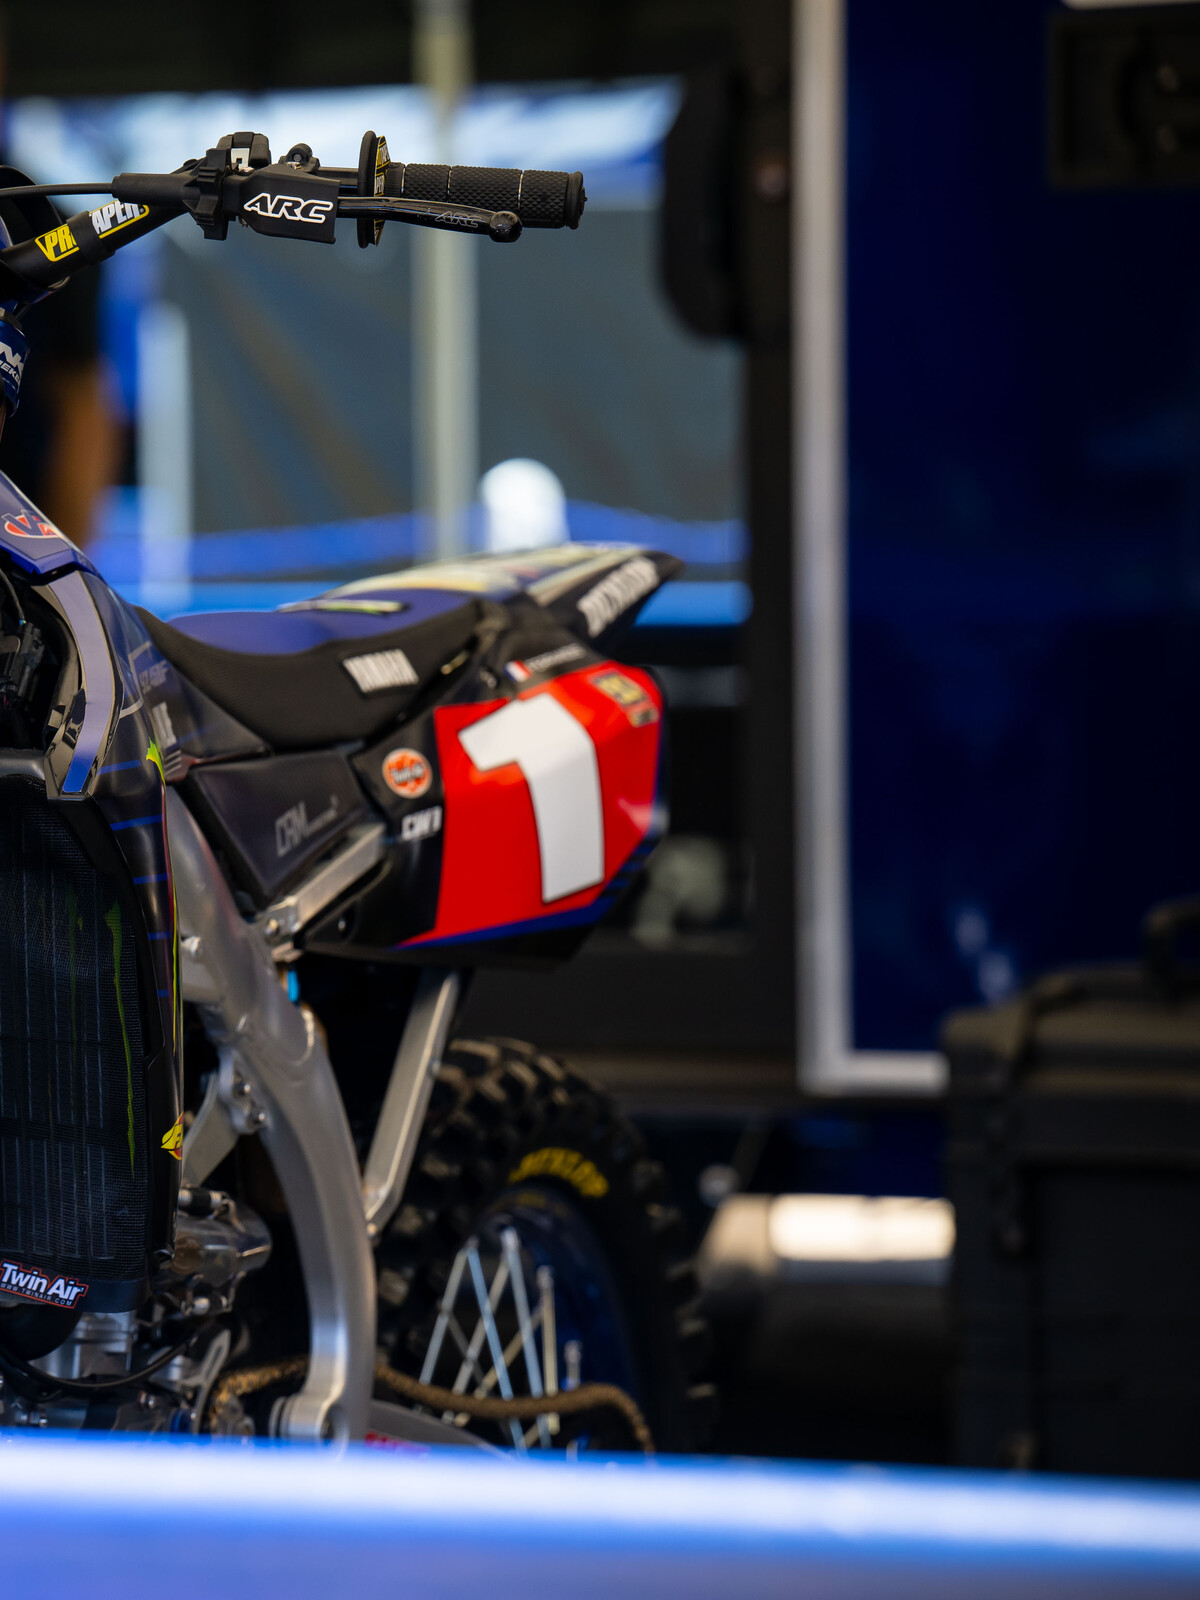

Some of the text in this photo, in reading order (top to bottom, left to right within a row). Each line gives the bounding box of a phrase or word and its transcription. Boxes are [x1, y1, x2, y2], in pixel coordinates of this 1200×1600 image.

[243, 192, 334, 224] ARC
[434, 212, 482, 228] ARC
[457, 692, 605, 904] 1
[1, 1262, 81, 1301] Twin Air
